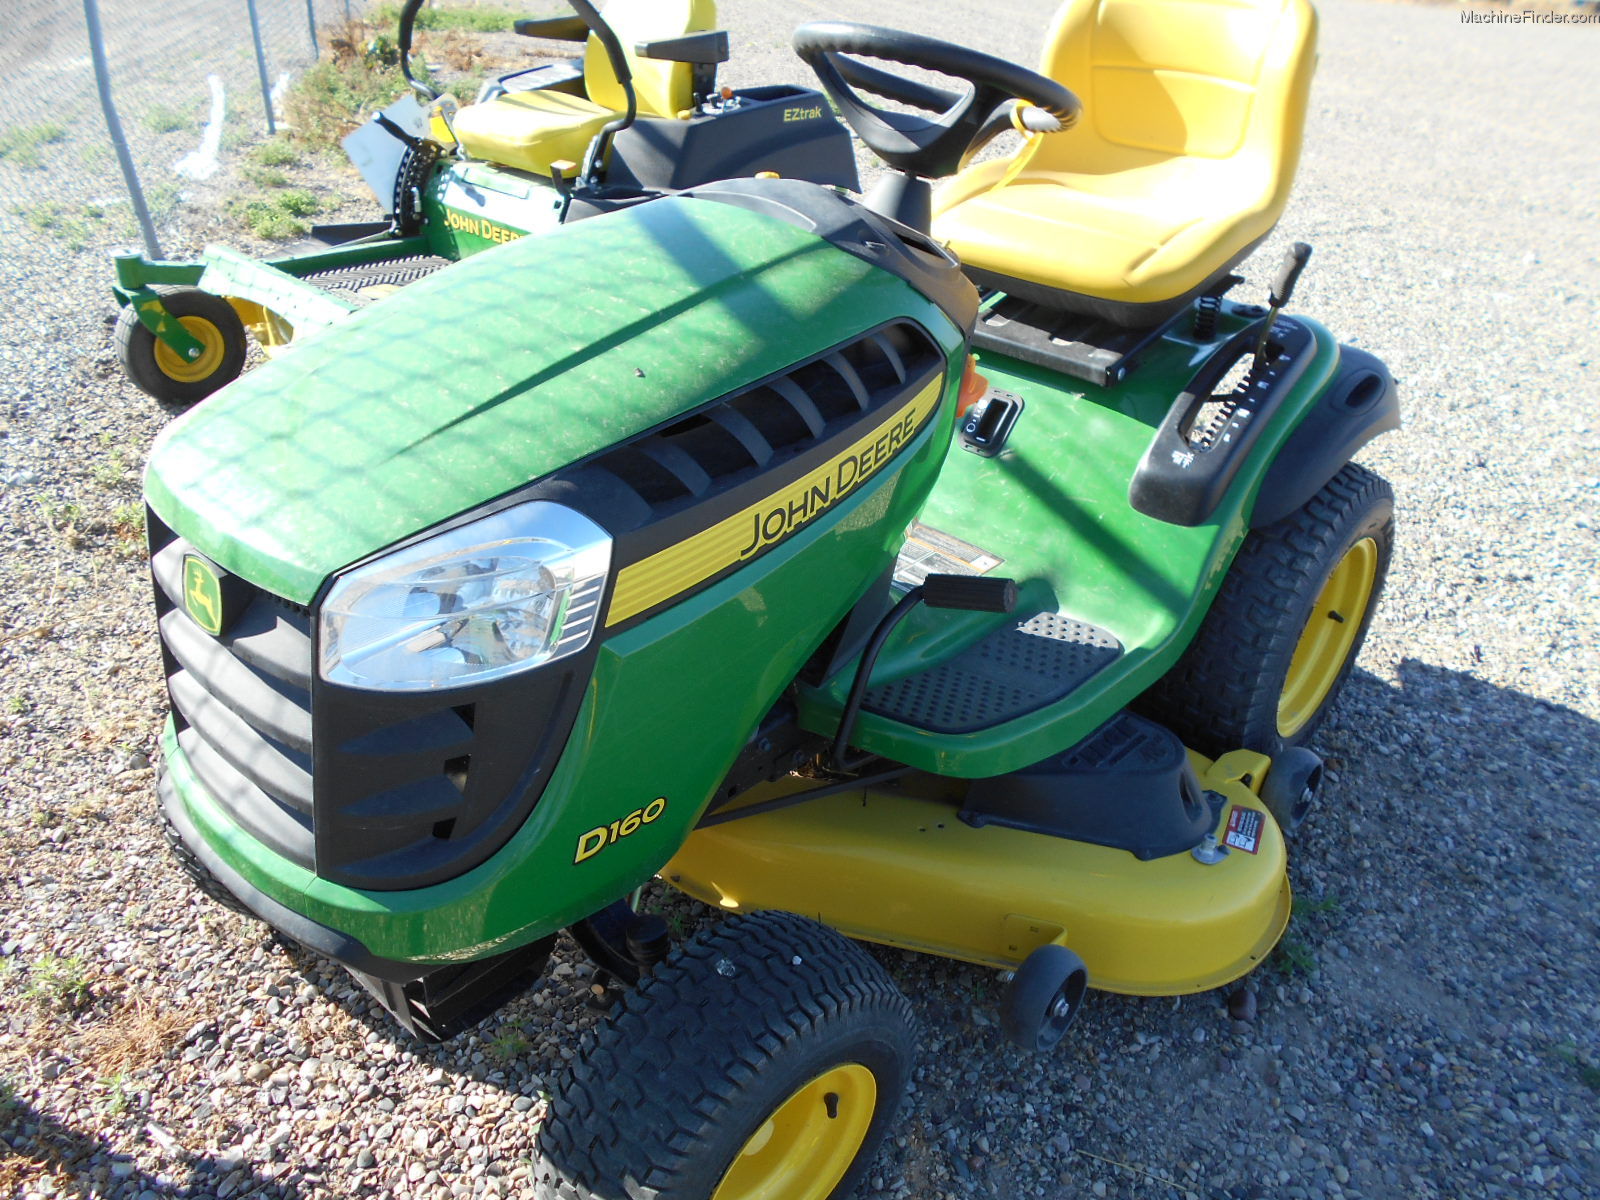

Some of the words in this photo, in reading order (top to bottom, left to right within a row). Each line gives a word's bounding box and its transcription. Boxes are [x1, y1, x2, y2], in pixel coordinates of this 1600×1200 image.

[783, 105, 822, 122] EZtrak
[444, 208, 480, 236] JOHN
[481, 218, 525, 245] DEE
[740, 475, 831, 558] JOHN
[836, 407, 917, 496] DEERE
[573, 797, 667, 864] D160
